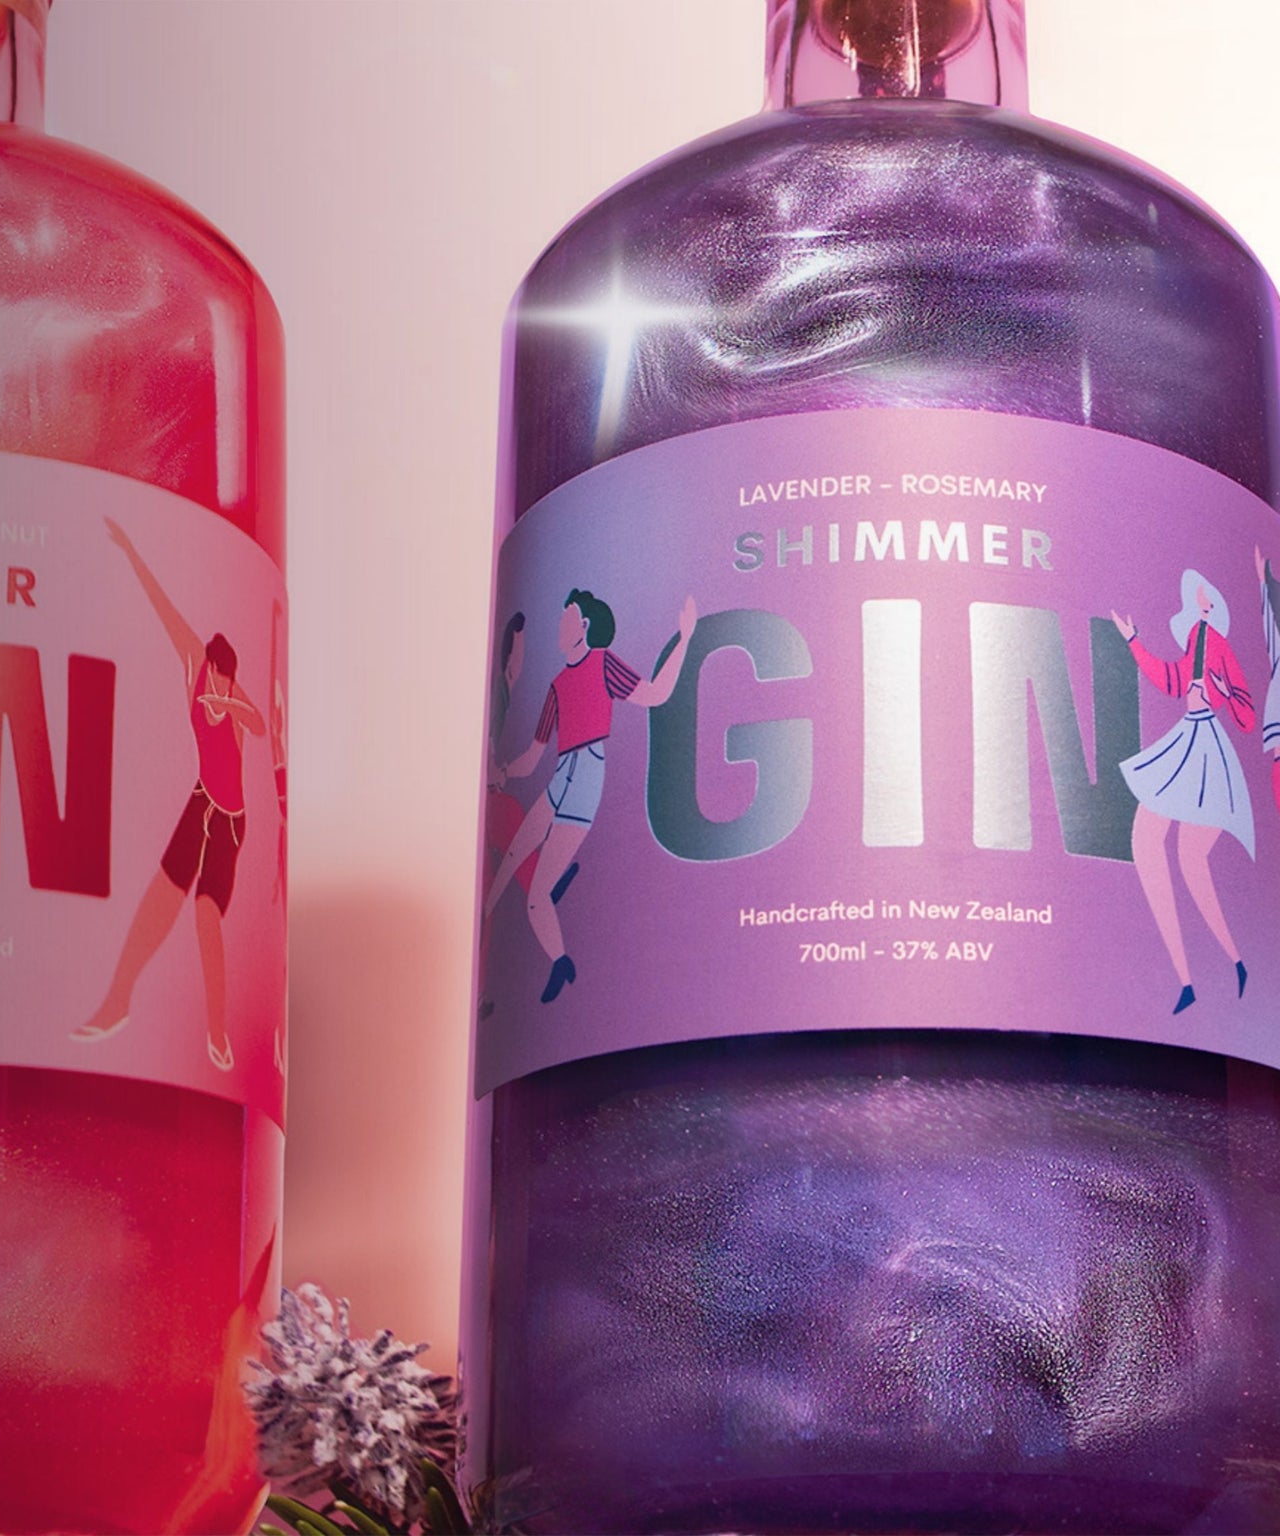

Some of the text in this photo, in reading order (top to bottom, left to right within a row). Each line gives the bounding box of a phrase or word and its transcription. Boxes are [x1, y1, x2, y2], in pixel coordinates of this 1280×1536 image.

[739, 475, 871, 506] LAVENDER
[902, 474, 1047, 503] ROSEMARY
[733, 520, 1055, 571] SHIMMER
[645, 599, 1143, 864] GIN
[740, 900, 1052, 927] Handcrafted in New Zealand
[800, 940, 867, 963] 700ml
[892, 940, 938, 962] 37%
[946, 941, 993, 962] ABV
